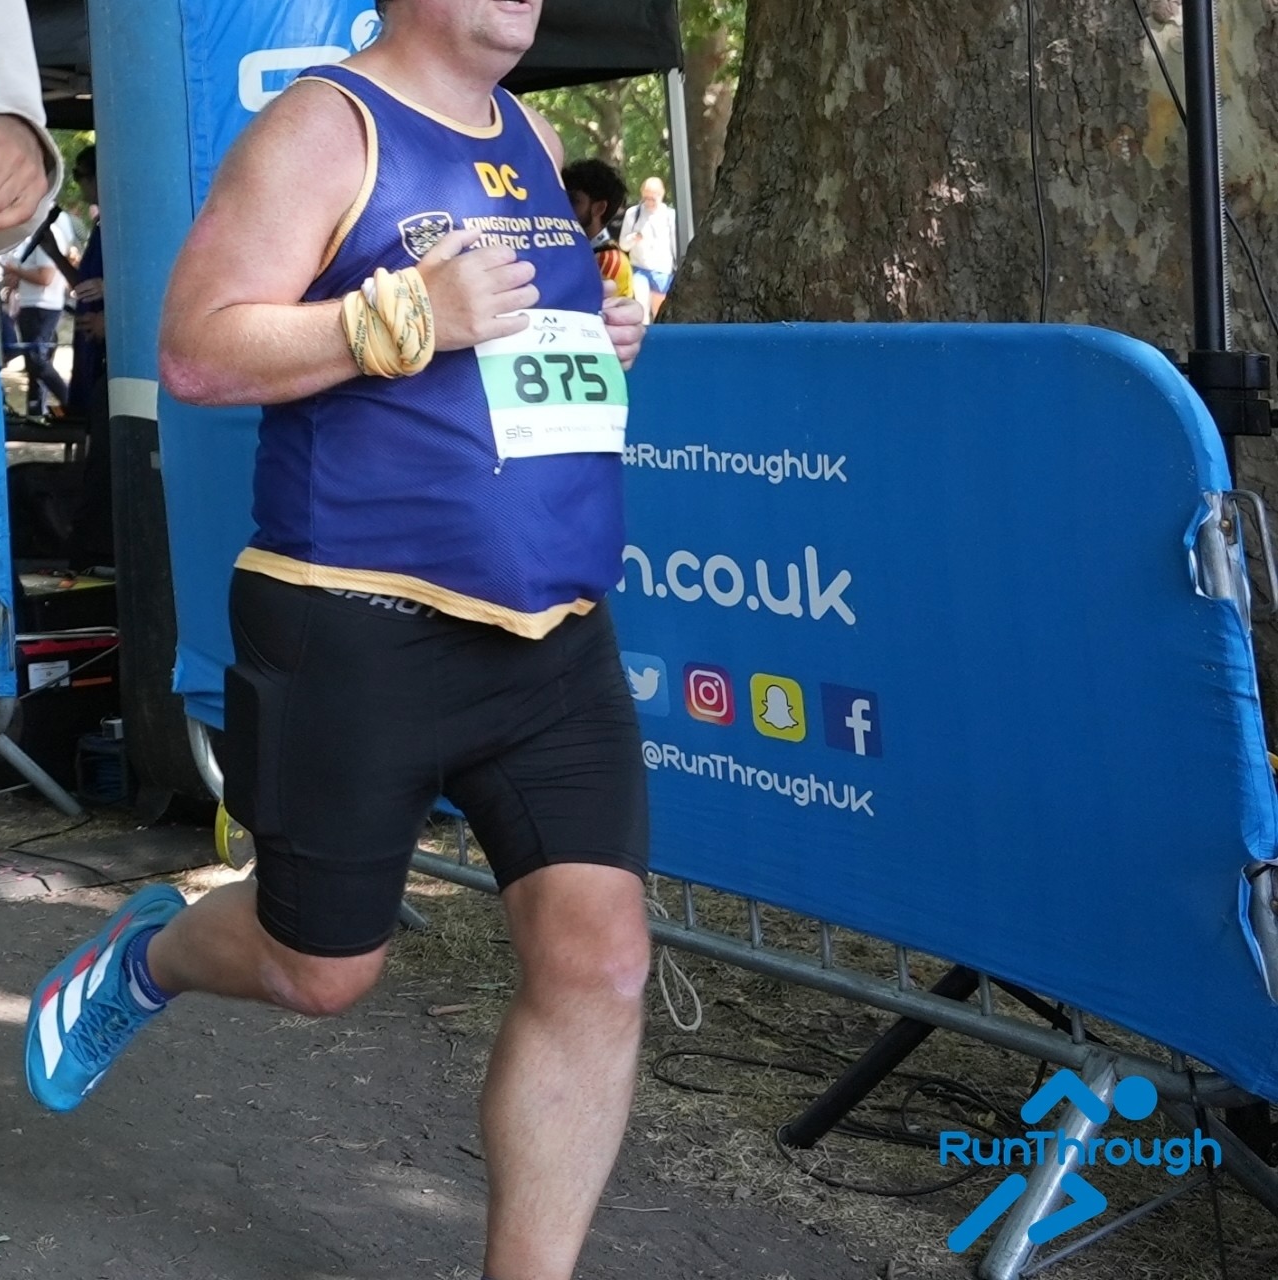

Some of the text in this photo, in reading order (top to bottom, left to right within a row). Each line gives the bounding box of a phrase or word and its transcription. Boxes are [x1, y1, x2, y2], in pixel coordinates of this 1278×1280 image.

[473, 162, 528, 201] DC
[462, 216, 532, 232] KINGSTON
[533, 215, 572, 233] UPON
[533, 232, 576, 249] CLUB
[513, 354, 608, 404] 875
[620, 443, 848, 484] #RunThroughUK
[642, 740, 875, 817] @RunThroughUK
